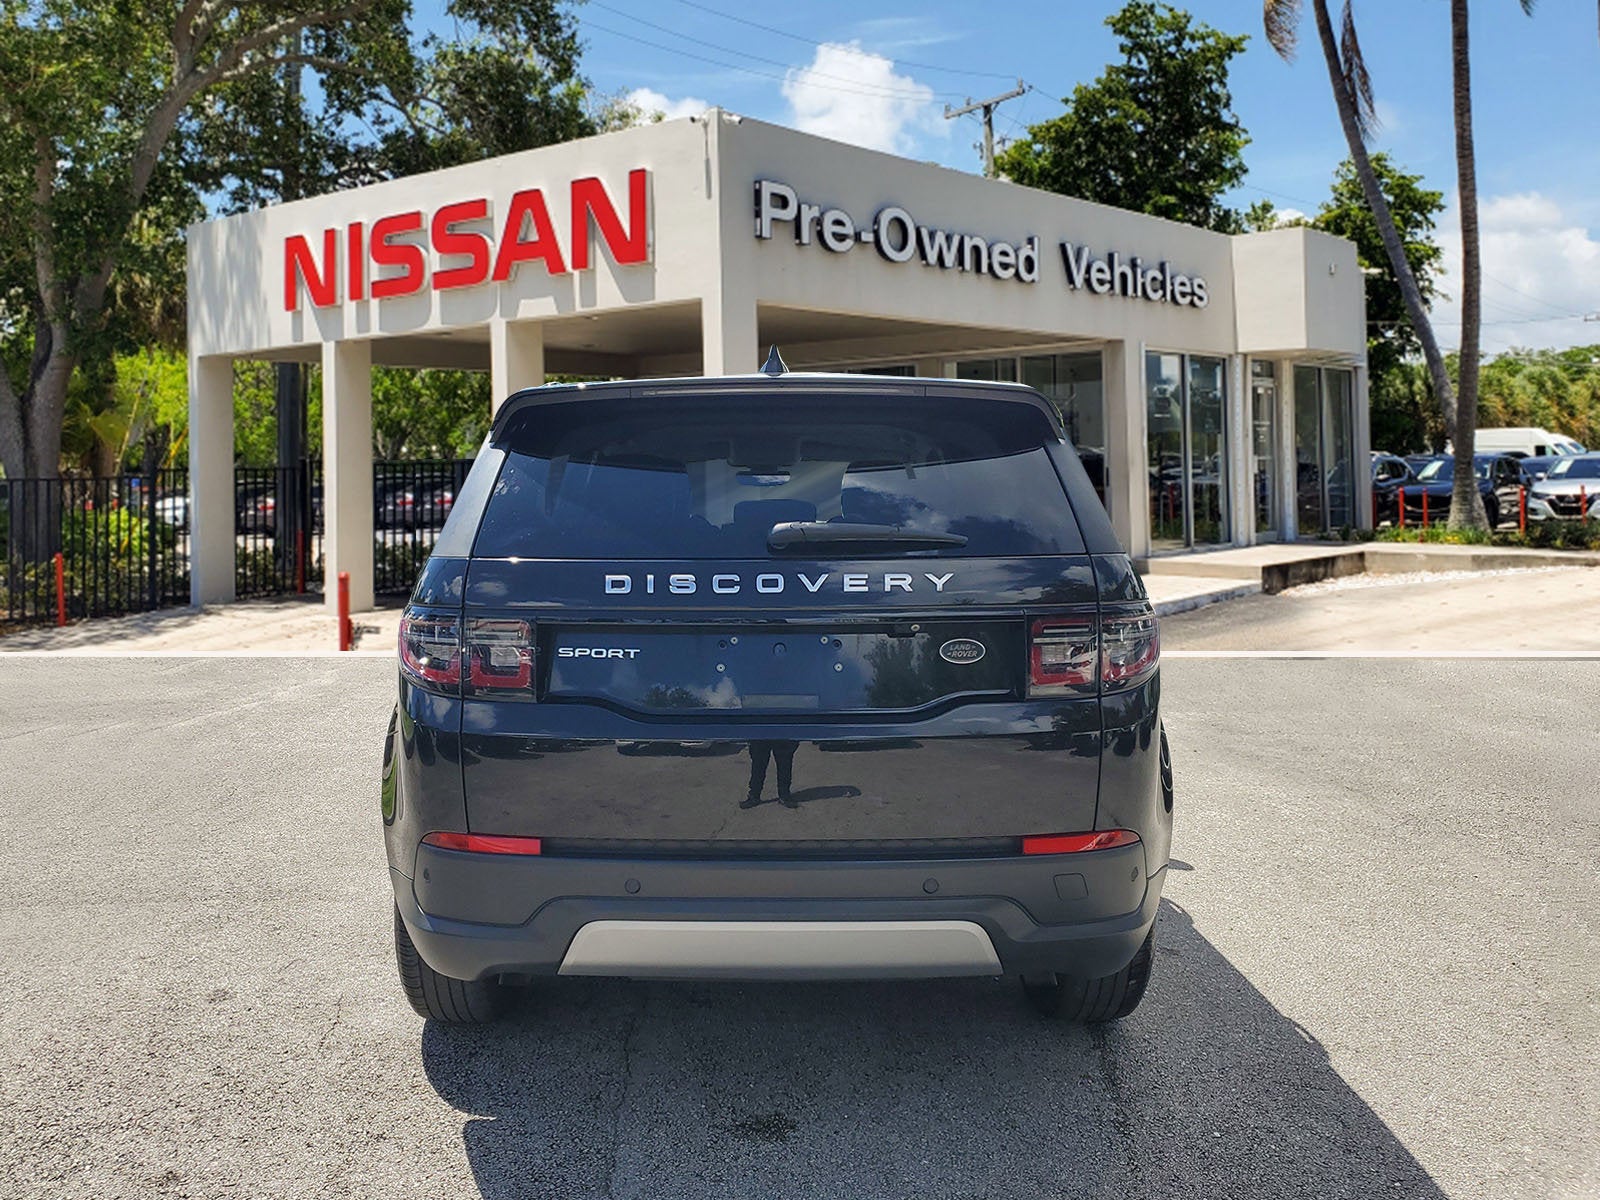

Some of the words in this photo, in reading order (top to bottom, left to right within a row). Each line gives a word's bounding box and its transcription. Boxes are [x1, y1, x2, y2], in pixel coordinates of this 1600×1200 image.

[284, 169, 647, 312] NISSAN
[754, 179, 1040, 283] Pre-Owned
[1060, 242, 1208, 308] Vehicles
[604, 573, 954, 594] DISCOVERY
[558, 647, 641, 659] SPORT
